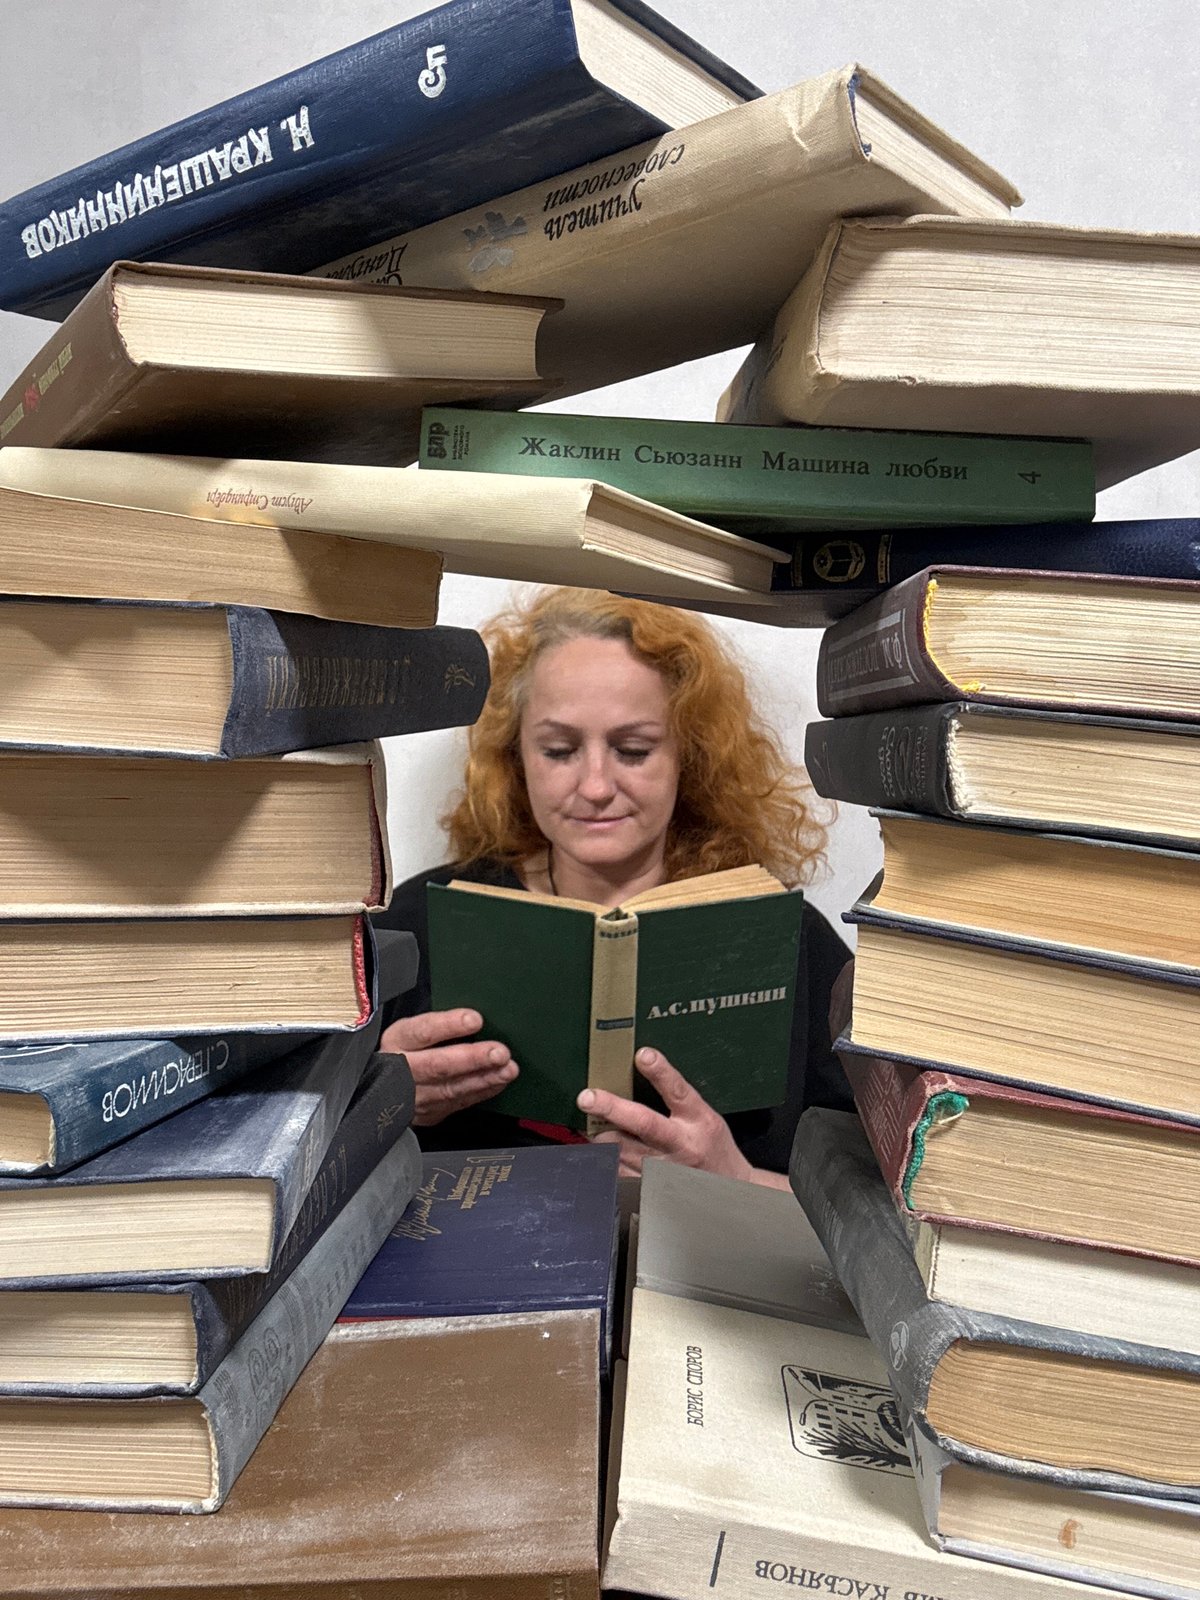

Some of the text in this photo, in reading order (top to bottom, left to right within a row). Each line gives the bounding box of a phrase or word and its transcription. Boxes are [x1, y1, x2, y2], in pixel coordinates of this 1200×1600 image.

[21, 105, 315, 259] Н. КРАШЕНИННИКОВ
[543, 144, 686, 213] словесности
[519, 436, 968, 480] Жаклин Сьюзанн Машина любви
[1017, 470, 1042, 485] 4
[686, 1345, 704, 1427] БОРИС СПОРОВ
[755, 1559, 890, 1600] КАСЬЯНОВ
